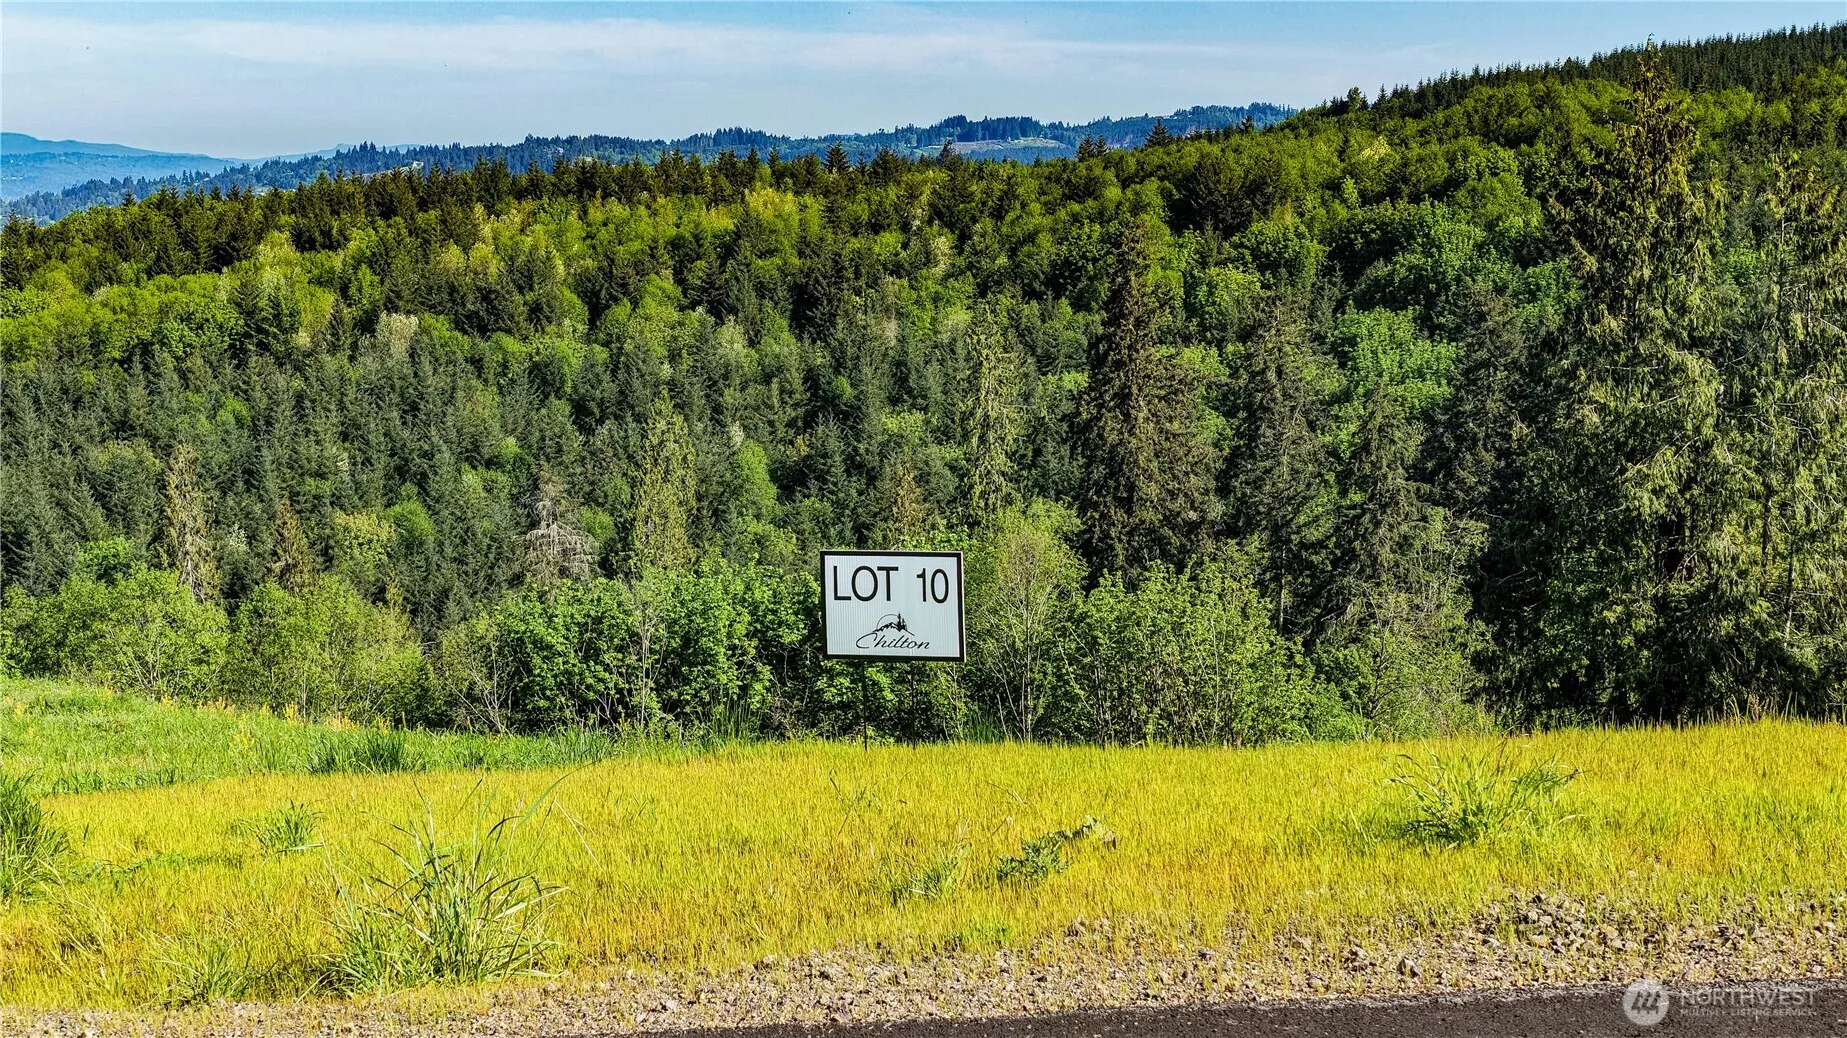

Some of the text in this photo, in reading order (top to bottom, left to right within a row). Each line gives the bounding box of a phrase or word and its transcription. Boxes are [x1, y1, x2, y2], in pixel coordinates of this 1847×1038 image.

[833, 565, 949, 604] LOT 10
[855, 632, 930, 650] Chilton
